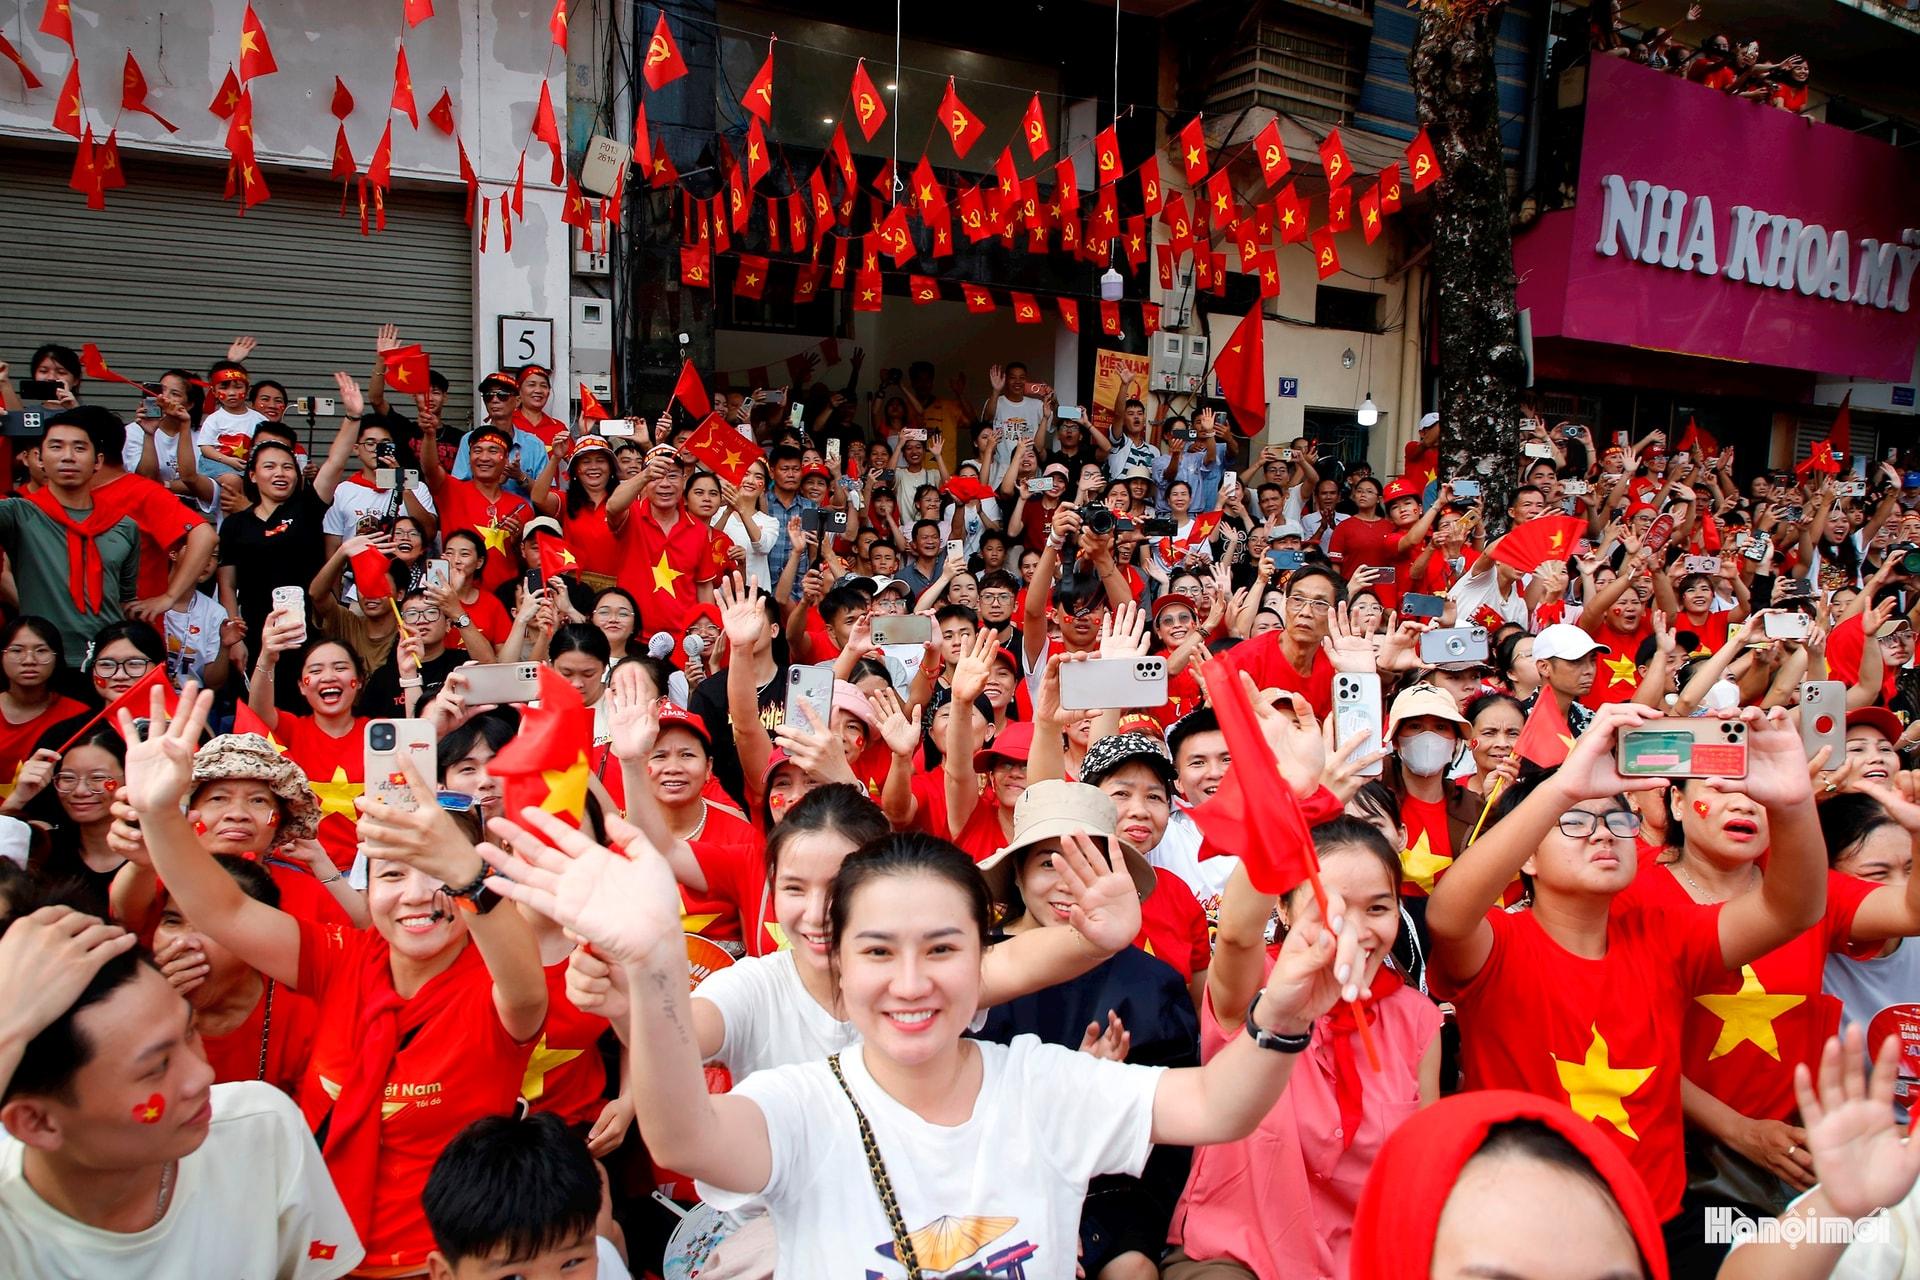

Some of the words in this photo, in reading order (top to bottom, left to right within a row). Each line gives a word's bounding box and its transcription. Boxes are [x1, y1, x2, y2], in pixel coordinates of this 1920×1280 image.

[1596, 174, 1718, 275] NHA
[1722, 205, 1850, 302] KHOA
[518, 330, 535, 360] 5
[402, 1083, 442, 1097] Nam
